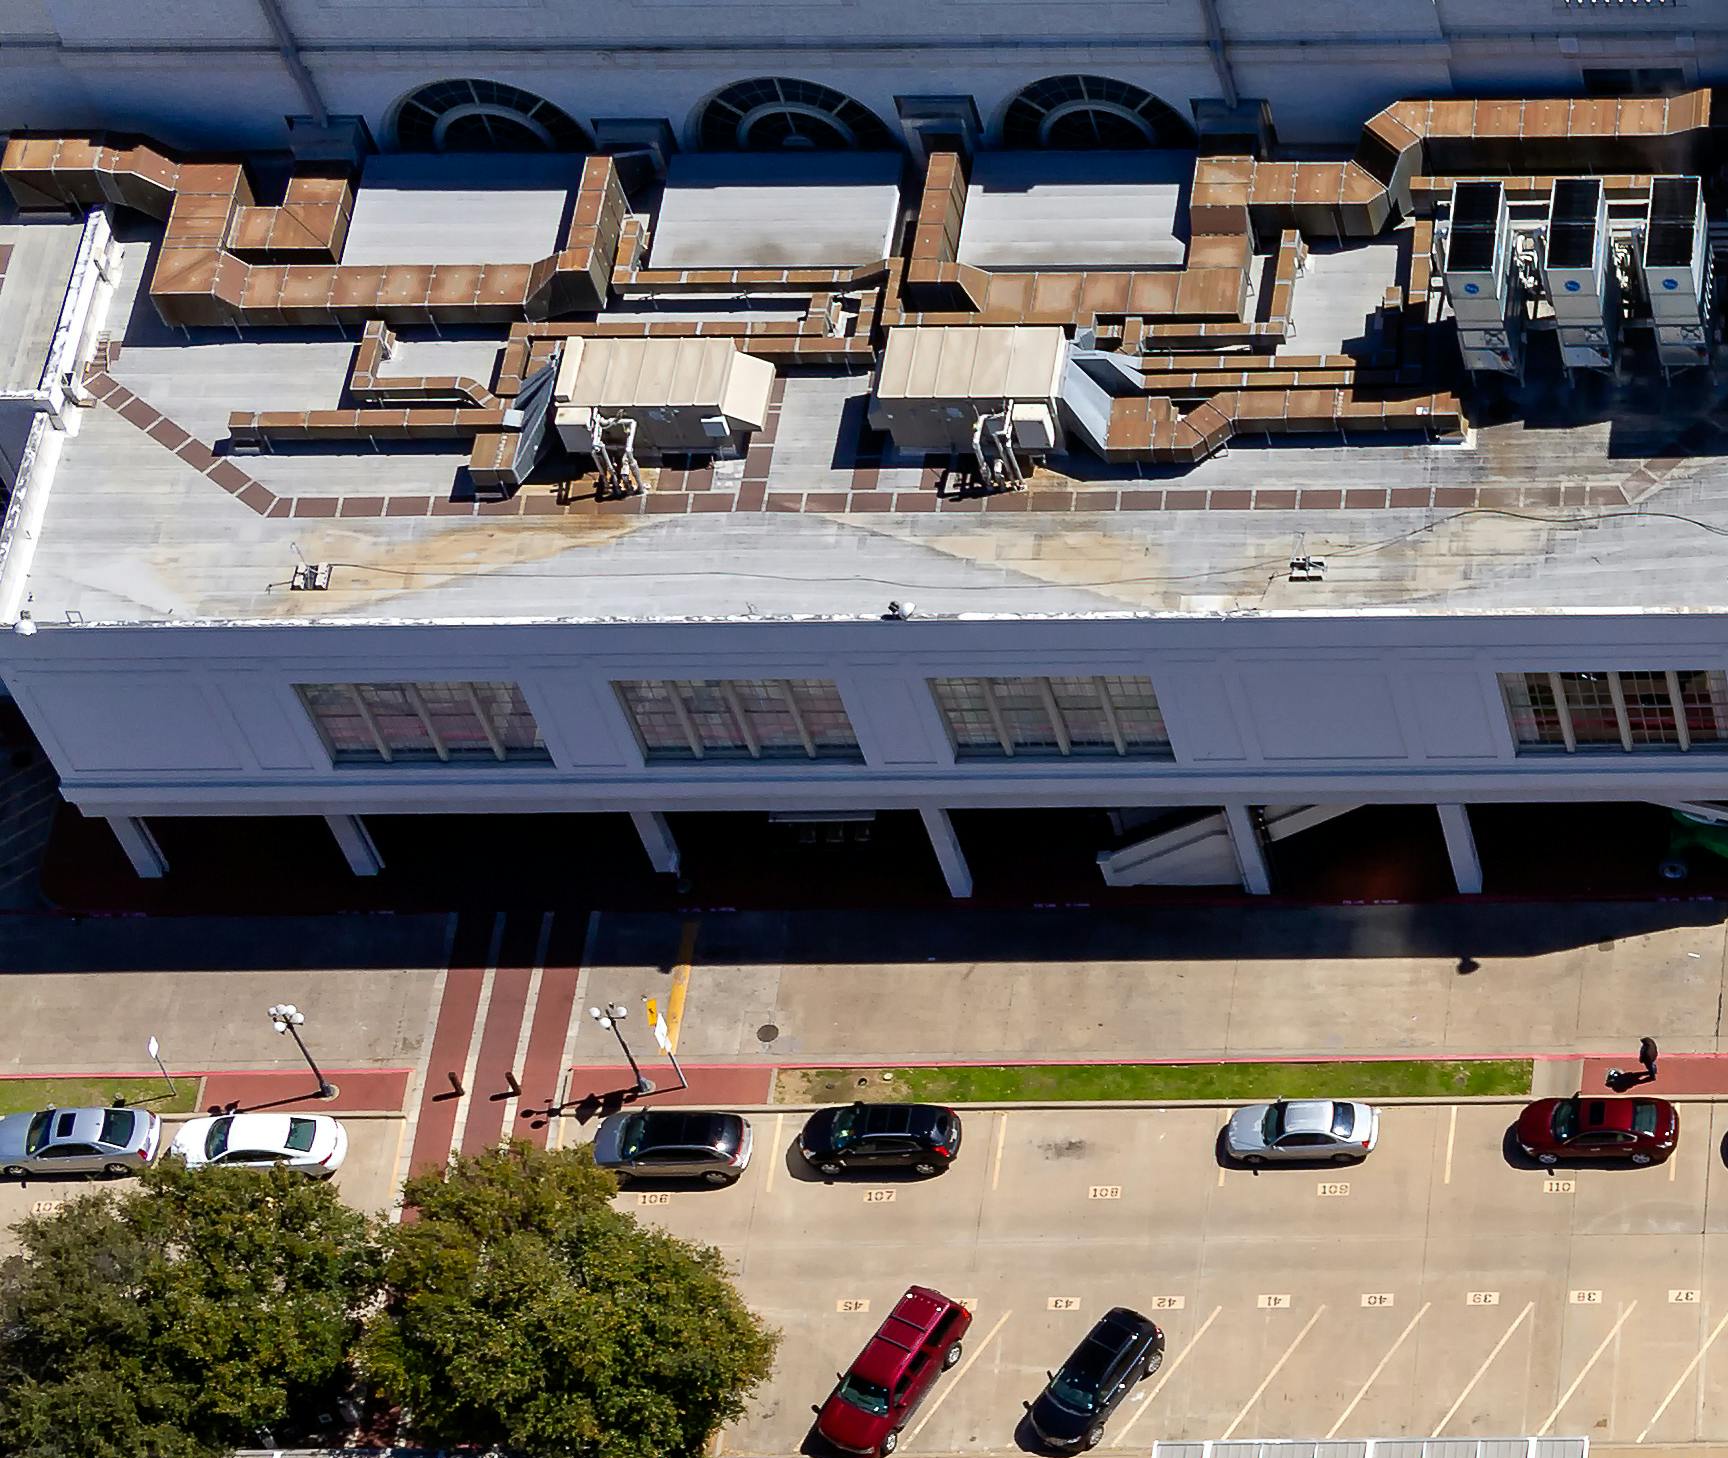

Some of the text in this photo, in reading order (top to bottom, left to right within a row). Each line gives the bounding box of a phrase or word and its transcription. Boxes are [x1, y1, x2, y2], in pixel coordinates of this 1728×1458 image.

[1322, 1185, 1349, 1194] 109
[1549, 1182, 1571, 1192] 110
[867, 1191, 894, 1201] 107
[1093, 1188, 1119, 1197] 108
[641, 1194, 669, 1204] 106
[1267, 1296, 1282, 1306] 41
[1367, 1295, 1388, 1305] 40
[1472, 1293, 1492, 1303] 39
[1577, 1292, 1596, 1302] 38
[1675, 1291, 1694, 1301] 37
[843, 1301, 864, 1311] 45
[1054, 1299, 1074, 1308] 43
[1157, 1298, 1177, 1307] 42
